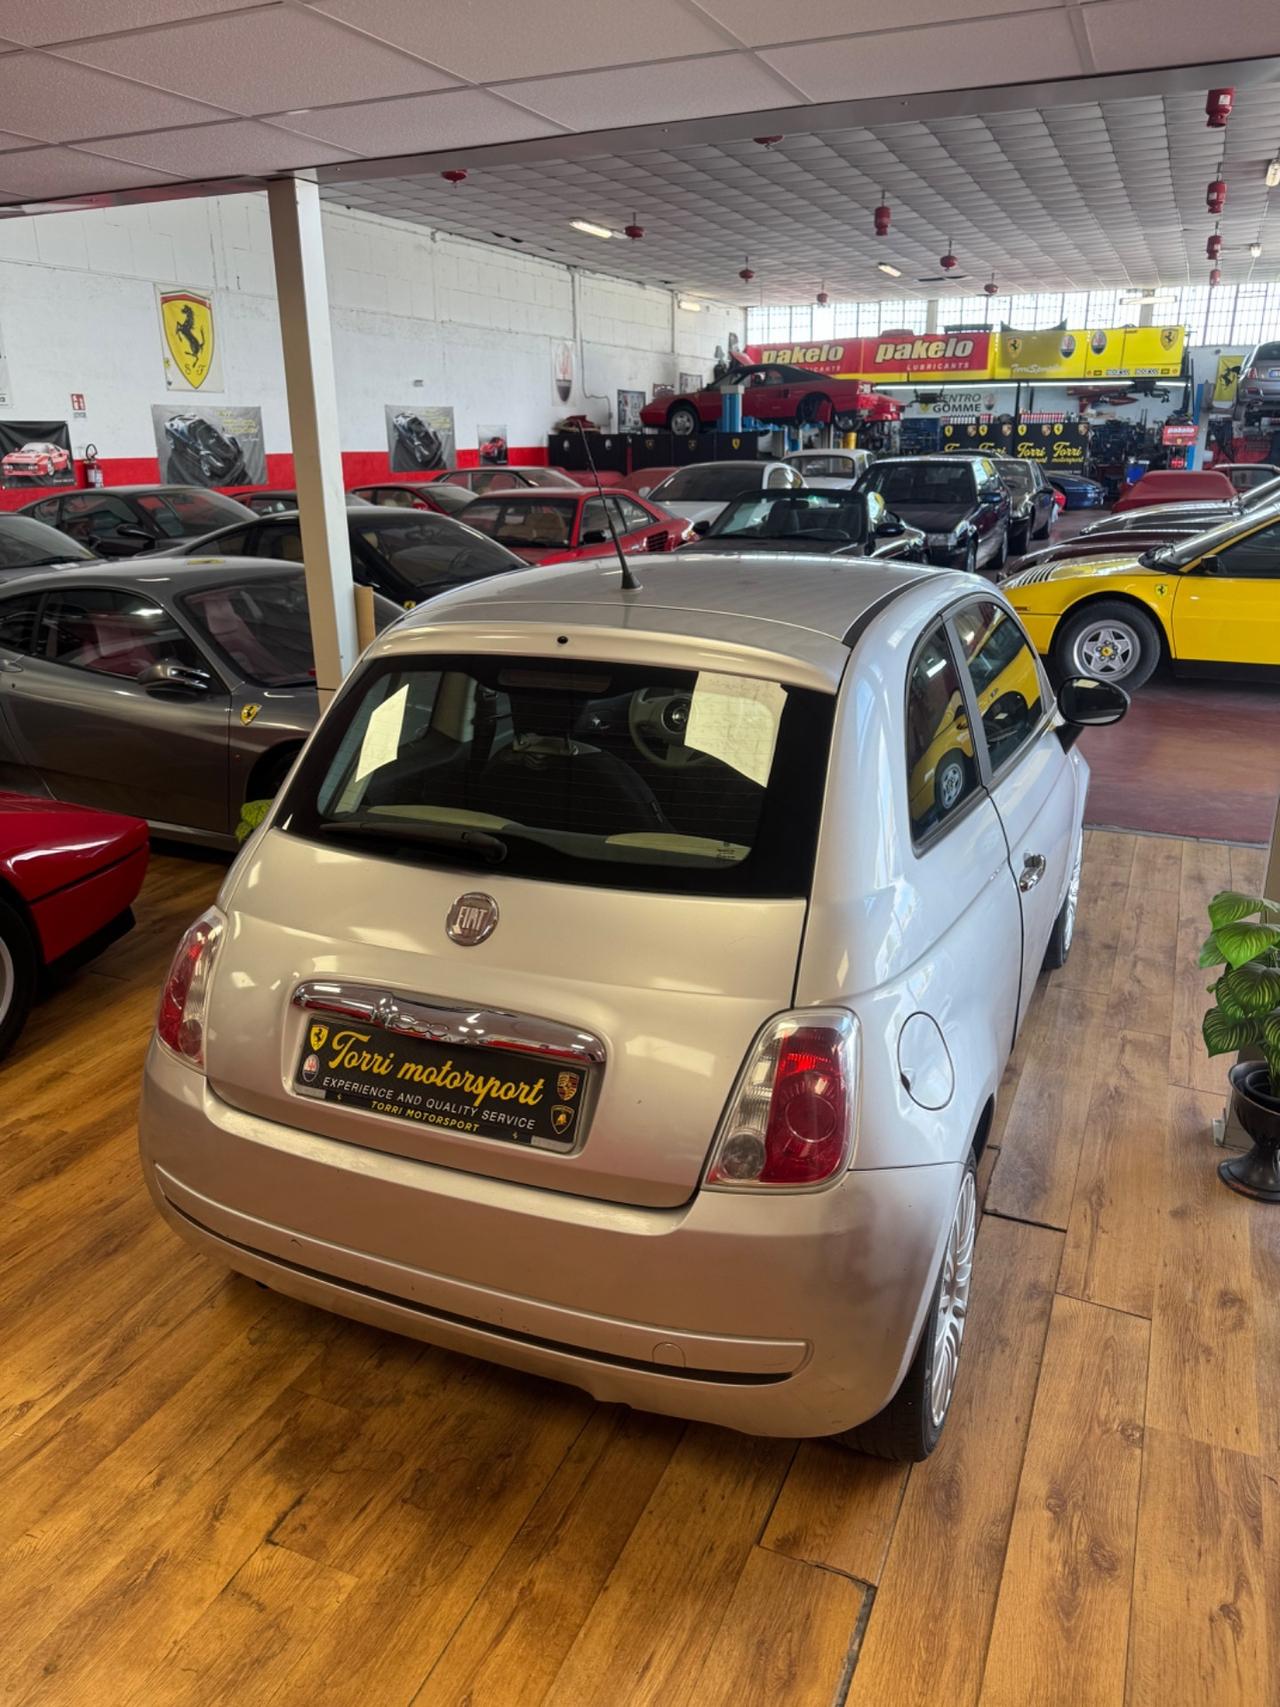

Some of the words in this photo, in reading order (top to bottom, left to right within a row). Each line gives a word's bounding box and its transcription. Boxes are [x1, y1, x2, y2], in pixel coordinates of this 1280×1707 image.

[762, 344, 844, 364] pakelo
[874, 338, 974, 363] pakelo
[906, 362, 970, 370] LUBRICANTS
[942, 393, 981, 402] ENTRO
[933, 403, 981, 413] GOMME
[1017, 442, 1047, 458] Torri
[1053, 441, 1082, 457] Torri
[456, 906, 488, 931] FIAT
[328, 1030, 395, 1075] Torri
[397, 1060, 545, 1107] motorsport
[322, 1077, 395, 1099] EXPERIENCE
[398, 1092, 422, 1105] AND
[425, 1098, 478, 1117] QUALITY
[481, 1110, 536, 1130] SERVICE
[371, 1101, 402, 1115] TORRI
[406, 1108, 480, 1132] MOTORSPORT
